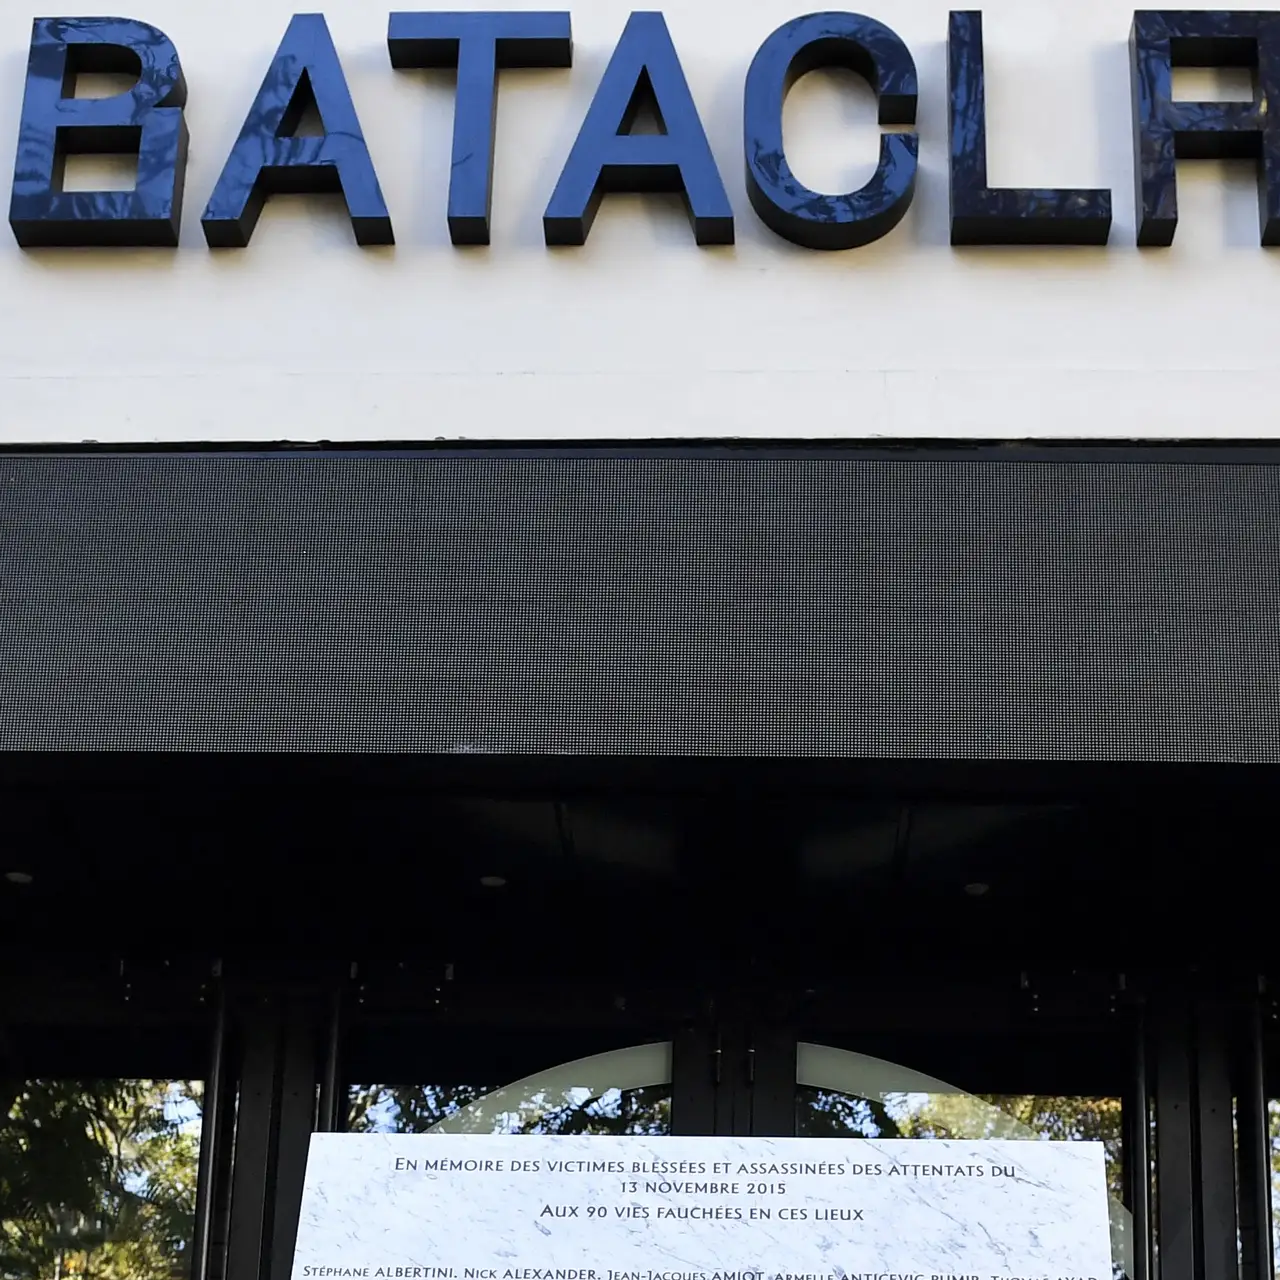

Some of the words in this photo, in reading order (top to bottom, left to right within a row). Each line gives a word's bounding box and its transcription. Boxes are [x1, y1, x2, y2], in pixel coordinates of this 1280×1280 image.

[395, 1157, 417, 1170] EN
[424, 1158, 503, 1171] MÉMOIRE
[510, 1160, 540, 1172] DES
[547, 1160, 625, 1173] VICTIMES
[631, 1160, 706, 1174] BLESSÉES
[713, 1162, 729, 1174] ET
[736, 1161, 845, 1175] ASSASSINÉES
[852, 1163, 882, 1175] DES
[887, 1163, 984, 1176] ATTENTATS
[991, 1165, 1015, 1177] DU
[621, 1181, 637, 1193] 13
[645, 1181, 739, 1194] NOVEMBRE
[747, 1182, 786, 1194] 2015
[539, 1205, 579, 1217] AUX
[586, 1205, 608, 1218] 90
[615, 1205, 650, 1218] VIES
[657, 1206, 742, 1219] FAUCHÉES
[749, 1207, 771, 1220] EN
[778, 1207, 808, 1220] CES
[815, 1208, 864, 1221] LIEUX
[303, 1265, 369, 1277] STÉPHANE
[374, 1266, 457, 1278] ALBERTINI.
[464, 1267, 497, 1279] NICK
[502, 1268, 601, 1280] ALEXANDER.
